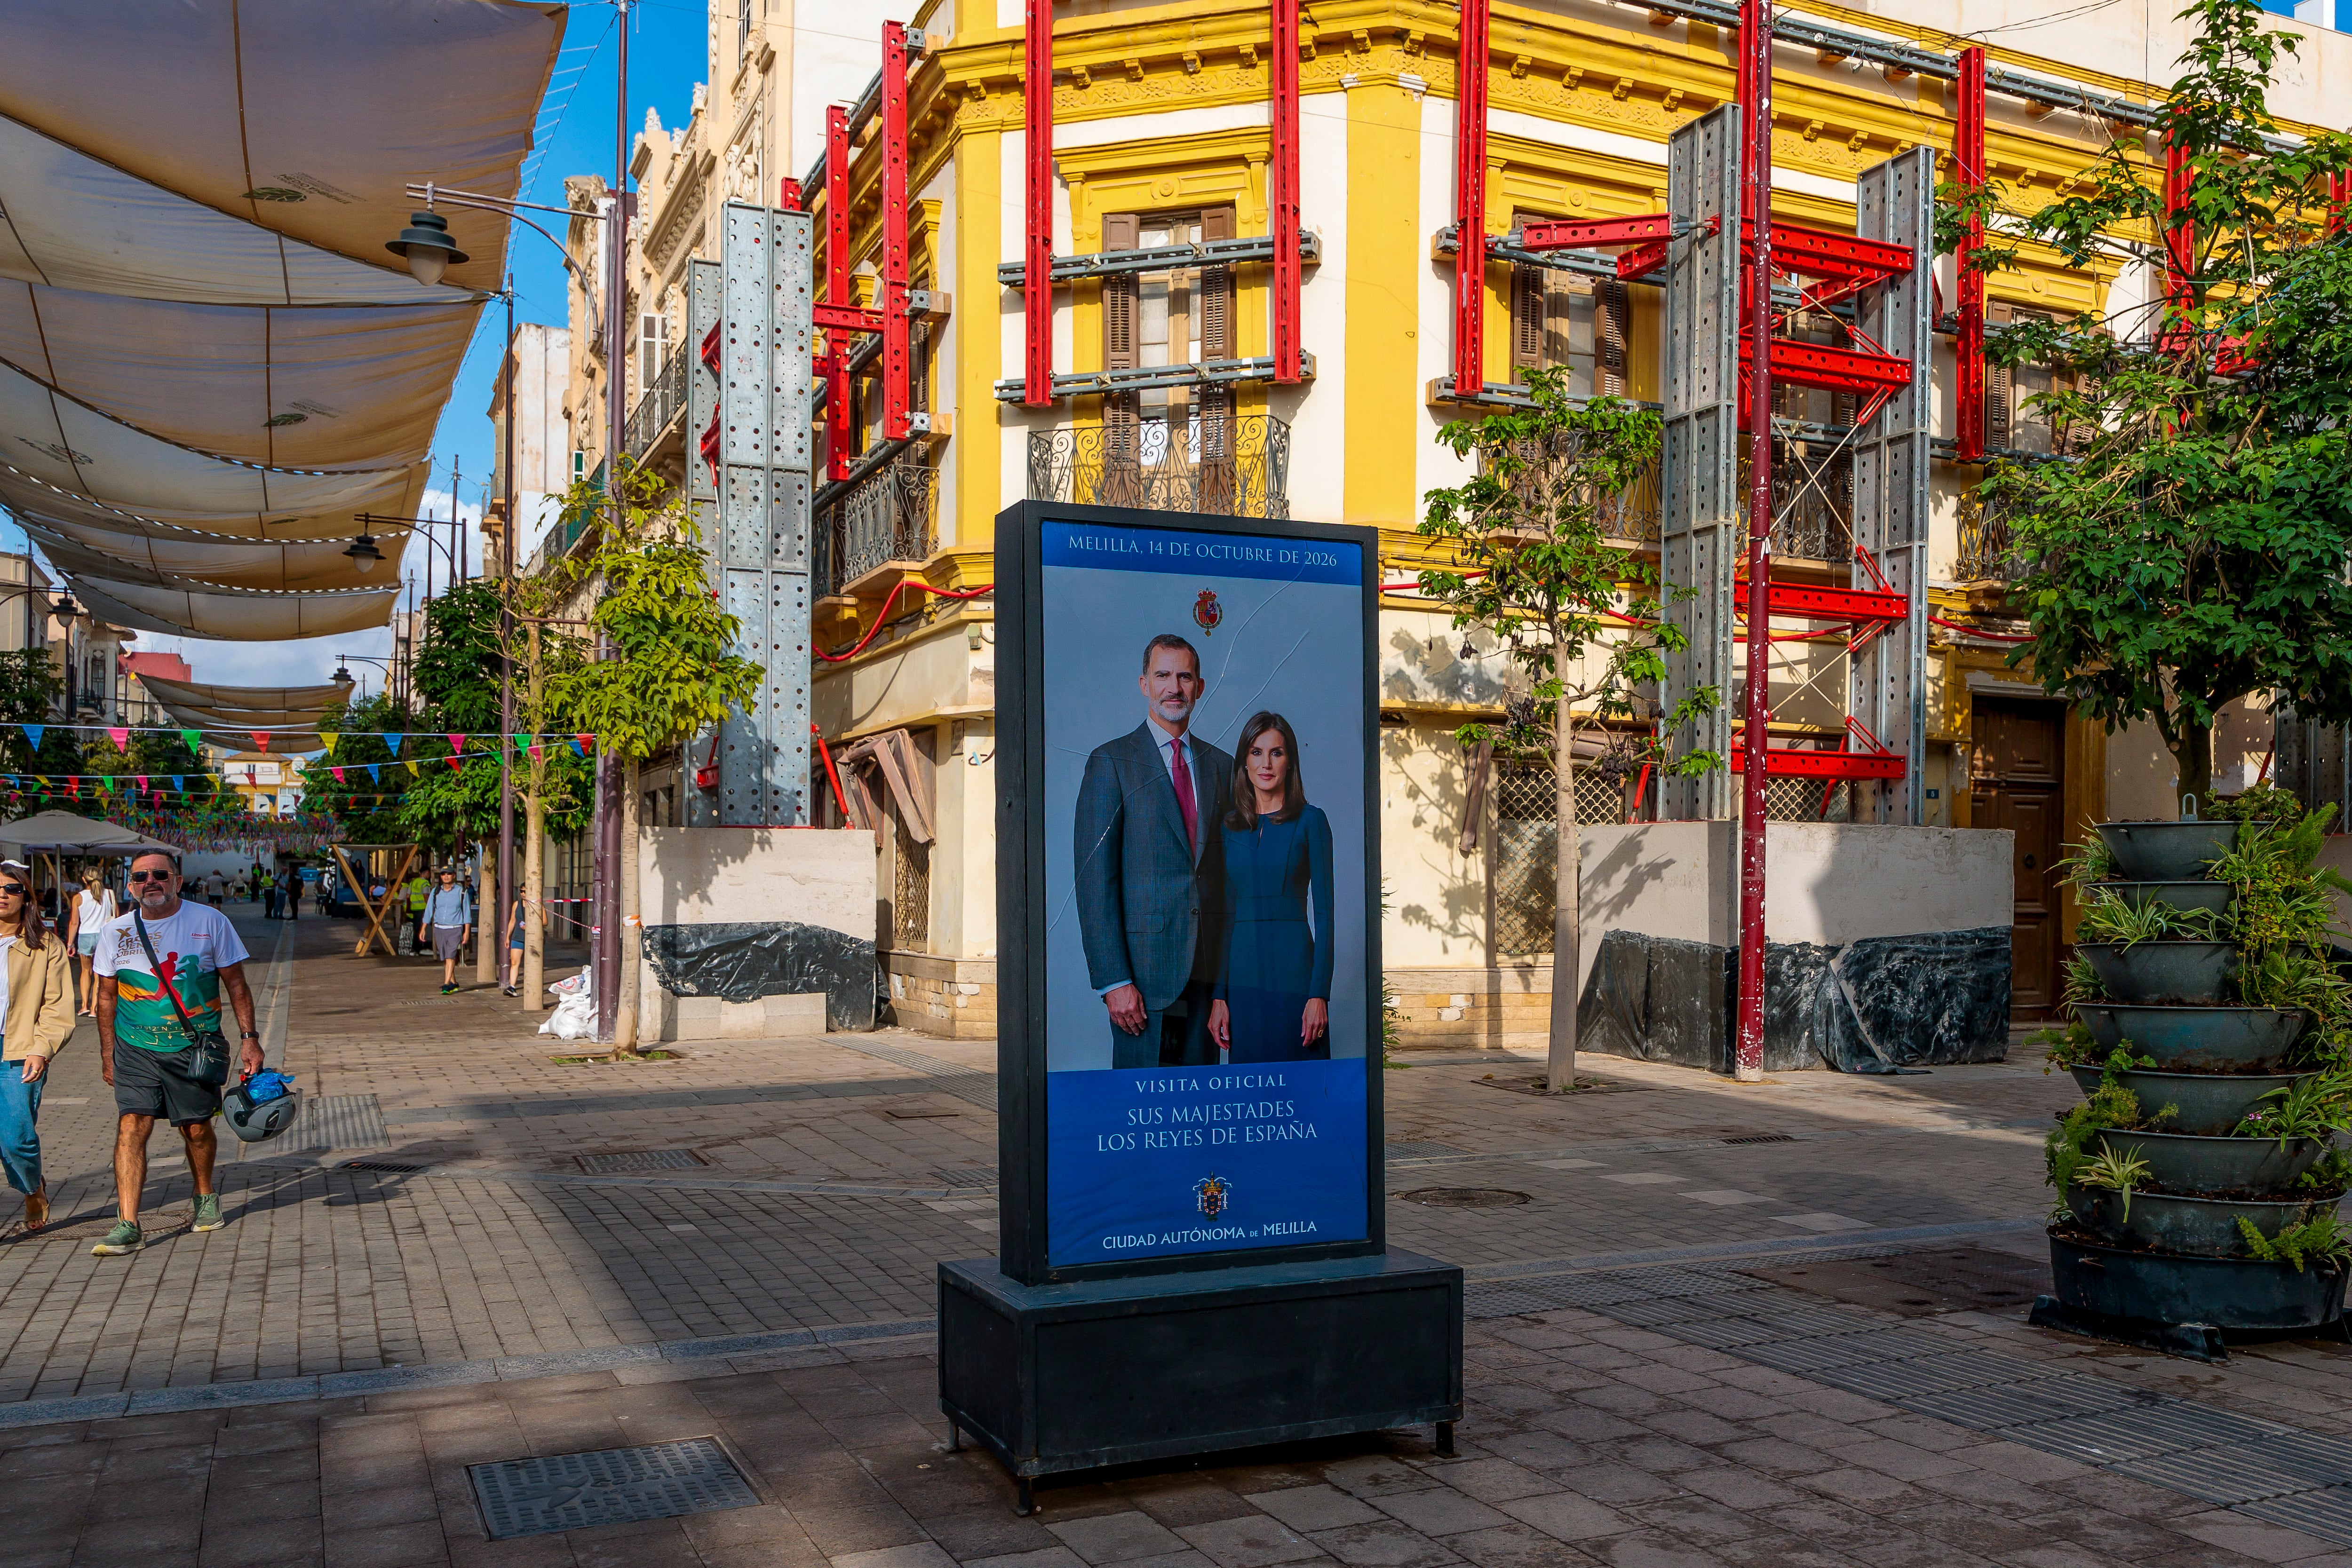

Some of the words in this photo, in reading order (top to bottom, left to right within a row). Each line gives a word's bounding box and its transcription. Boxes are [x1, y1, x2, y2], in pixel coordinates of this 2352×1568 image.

[1069, 535, 1144, 554] MELILLA,
[1149, 541, 1163, 554] 14
[1170, 542, 1191, 556] DE
[1196, 544, 1273, 562] OCTUBRE
[1279, 550, 1299, 564] DE
[1304, 551, 1337, 566] 2026
[1135, 1078, 1200, 1093] VISITA
[1209, 1074, 1287, 1090] OFICIAL
[1128, 1107, 1163, 1125] SUS
[1171, 1100, 1294, 1125] MAJESTADES
[1098, 1132, 1136, 1151] LOS
[1144, 1129, 1203, 1148] REYES
[1212, 1127, 1237, 1144] DE
[1245, 1120, 1318, 1142] ESPAÑA
[1103, 1233, 1157, 1249] CIUDAD
[1160, 1227, 1246, 1244] AUTÓNOMA
[1263, 1220, 1318, 1236] MELILLA
